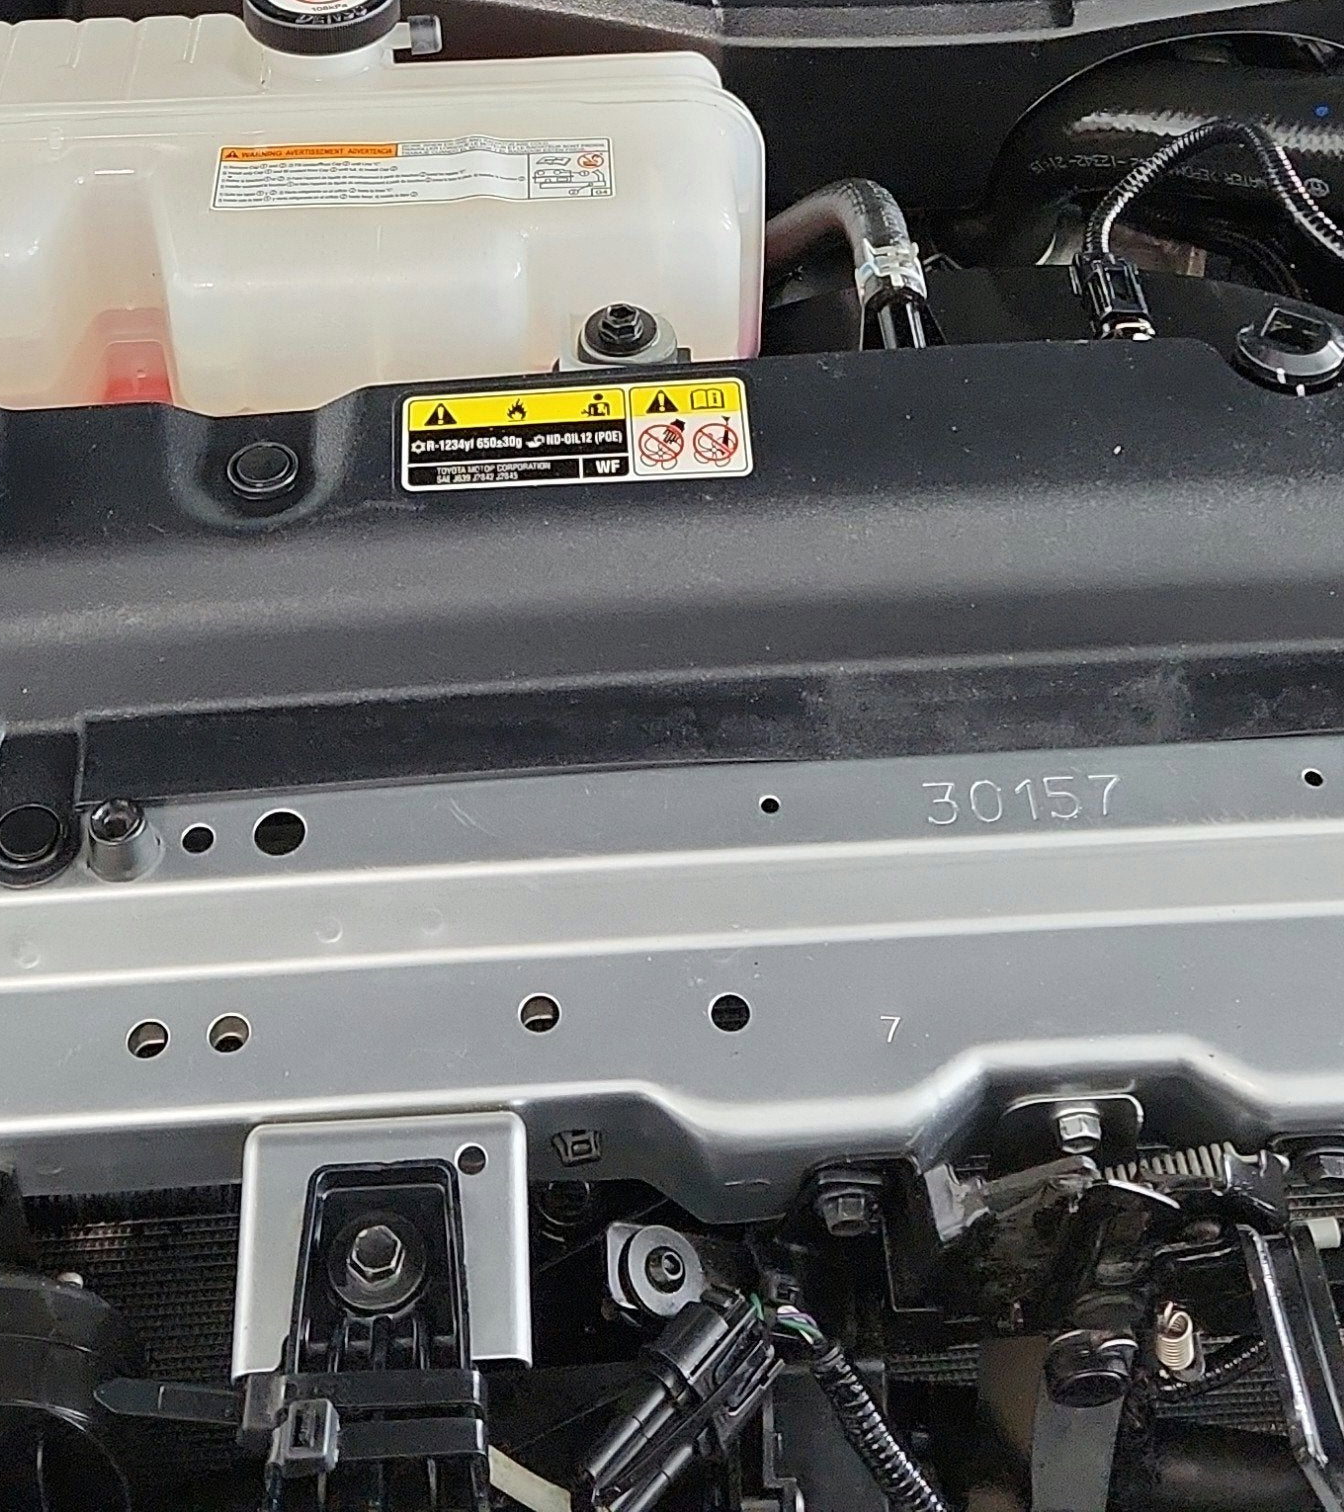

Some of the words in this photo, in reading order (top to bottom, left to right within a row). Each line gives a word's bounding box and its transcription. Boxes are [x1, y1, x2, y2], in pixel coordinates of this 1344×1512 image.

[295, 6, 368, 24] DENSO
[241, 150, 283, 159] WARNING
[426, 437, 474, 454] R-1234yf
[595, 430, 623, 444] (POE)
[436, 465, 467, 475] TOYOTA
[496, 462, 551, 472] CORPORATION
[595, 460, 621, 474] WF
[436, 474, 451, 483] SAE
[922, 773, 1121, 826] 30157
[878, 1016, 901, 1045] 7
